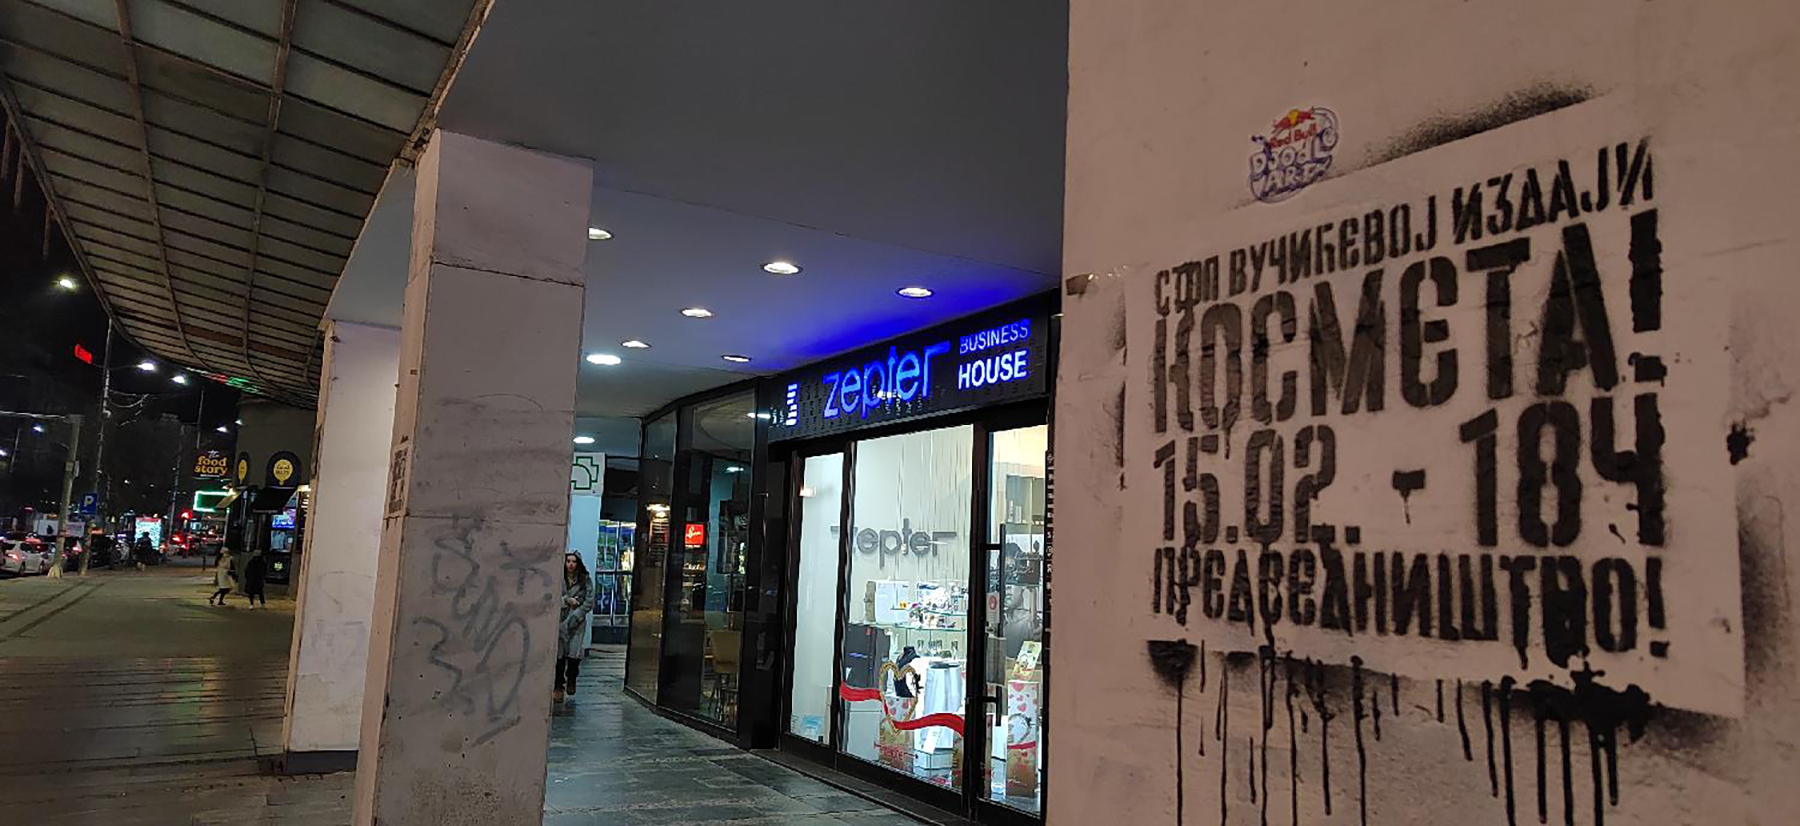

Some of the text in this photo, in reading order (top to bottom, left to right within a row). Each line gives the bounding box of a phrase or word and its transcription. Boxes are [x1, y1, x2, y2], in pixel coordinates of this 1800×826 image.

[1294, 122, 1317, 142] Bull
[1228, 196, 1438, 297] ВУЧИЋЕВОЈ
[1452, 137, 1655, 244] ИЗДАЈИ
[959, 319, 1031, 354] BUSINESS
[1154, 208, 1667, 434] КОСМЕТА!
[822, 342, 951, 419] zepter
[958, 350, 1028, 389] HOUSE
[194, 465, 228, 476] story
[197, 455, 227, 466] food
[1154, 424, 1361, 545] 15.02.
[1153, 547, 1669, 664] ПРЕДСЕДНИШТВО!
